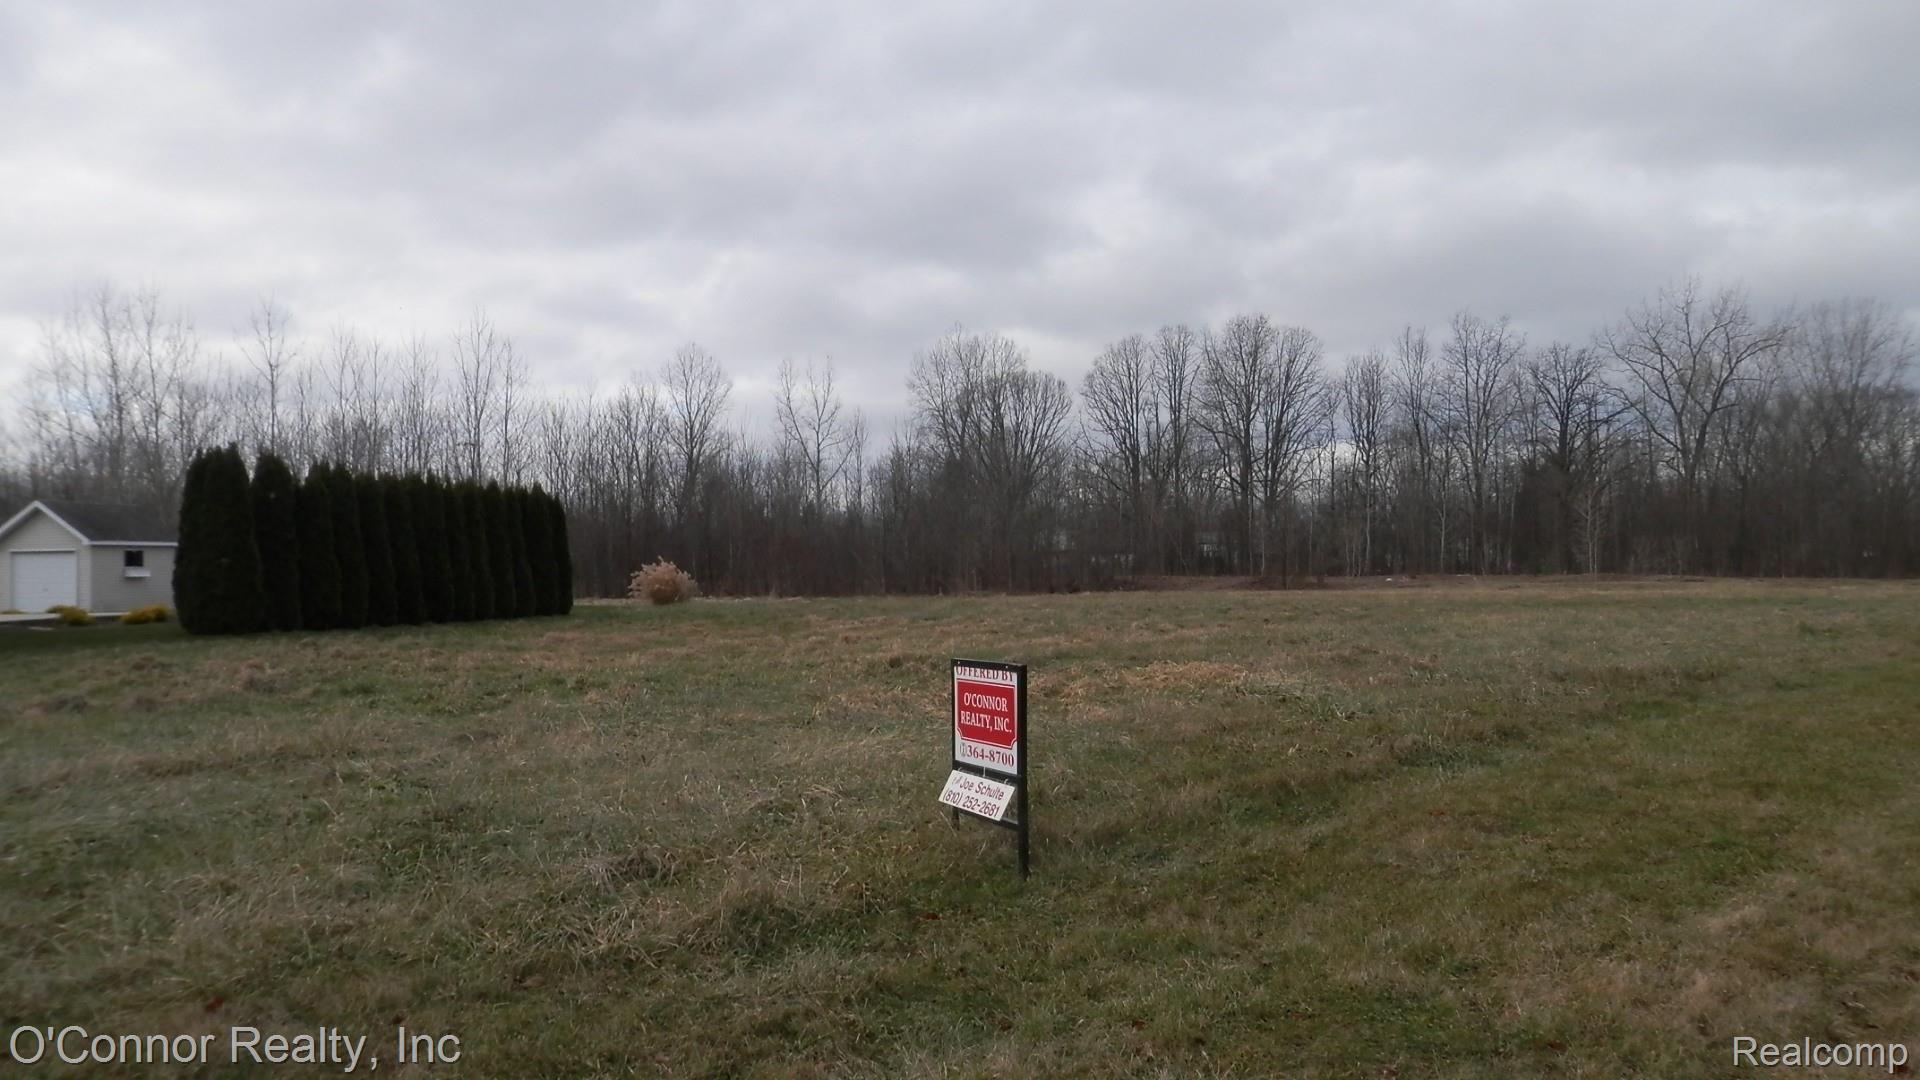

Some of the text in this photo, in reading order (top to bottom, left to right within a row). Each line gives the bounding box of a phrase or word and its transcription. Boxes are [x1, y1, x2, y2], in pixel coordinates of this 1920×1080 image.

[956, 666, 1014, 681] OFFERED BY
[964, 692, 1008, 712] O'CONNOR
[961, 710, 1012, 733] REALTY, INC.
[960, 776, 1004, 801] Joe Schulte
[943, 788, 1000, 818] (810) 252-2681
